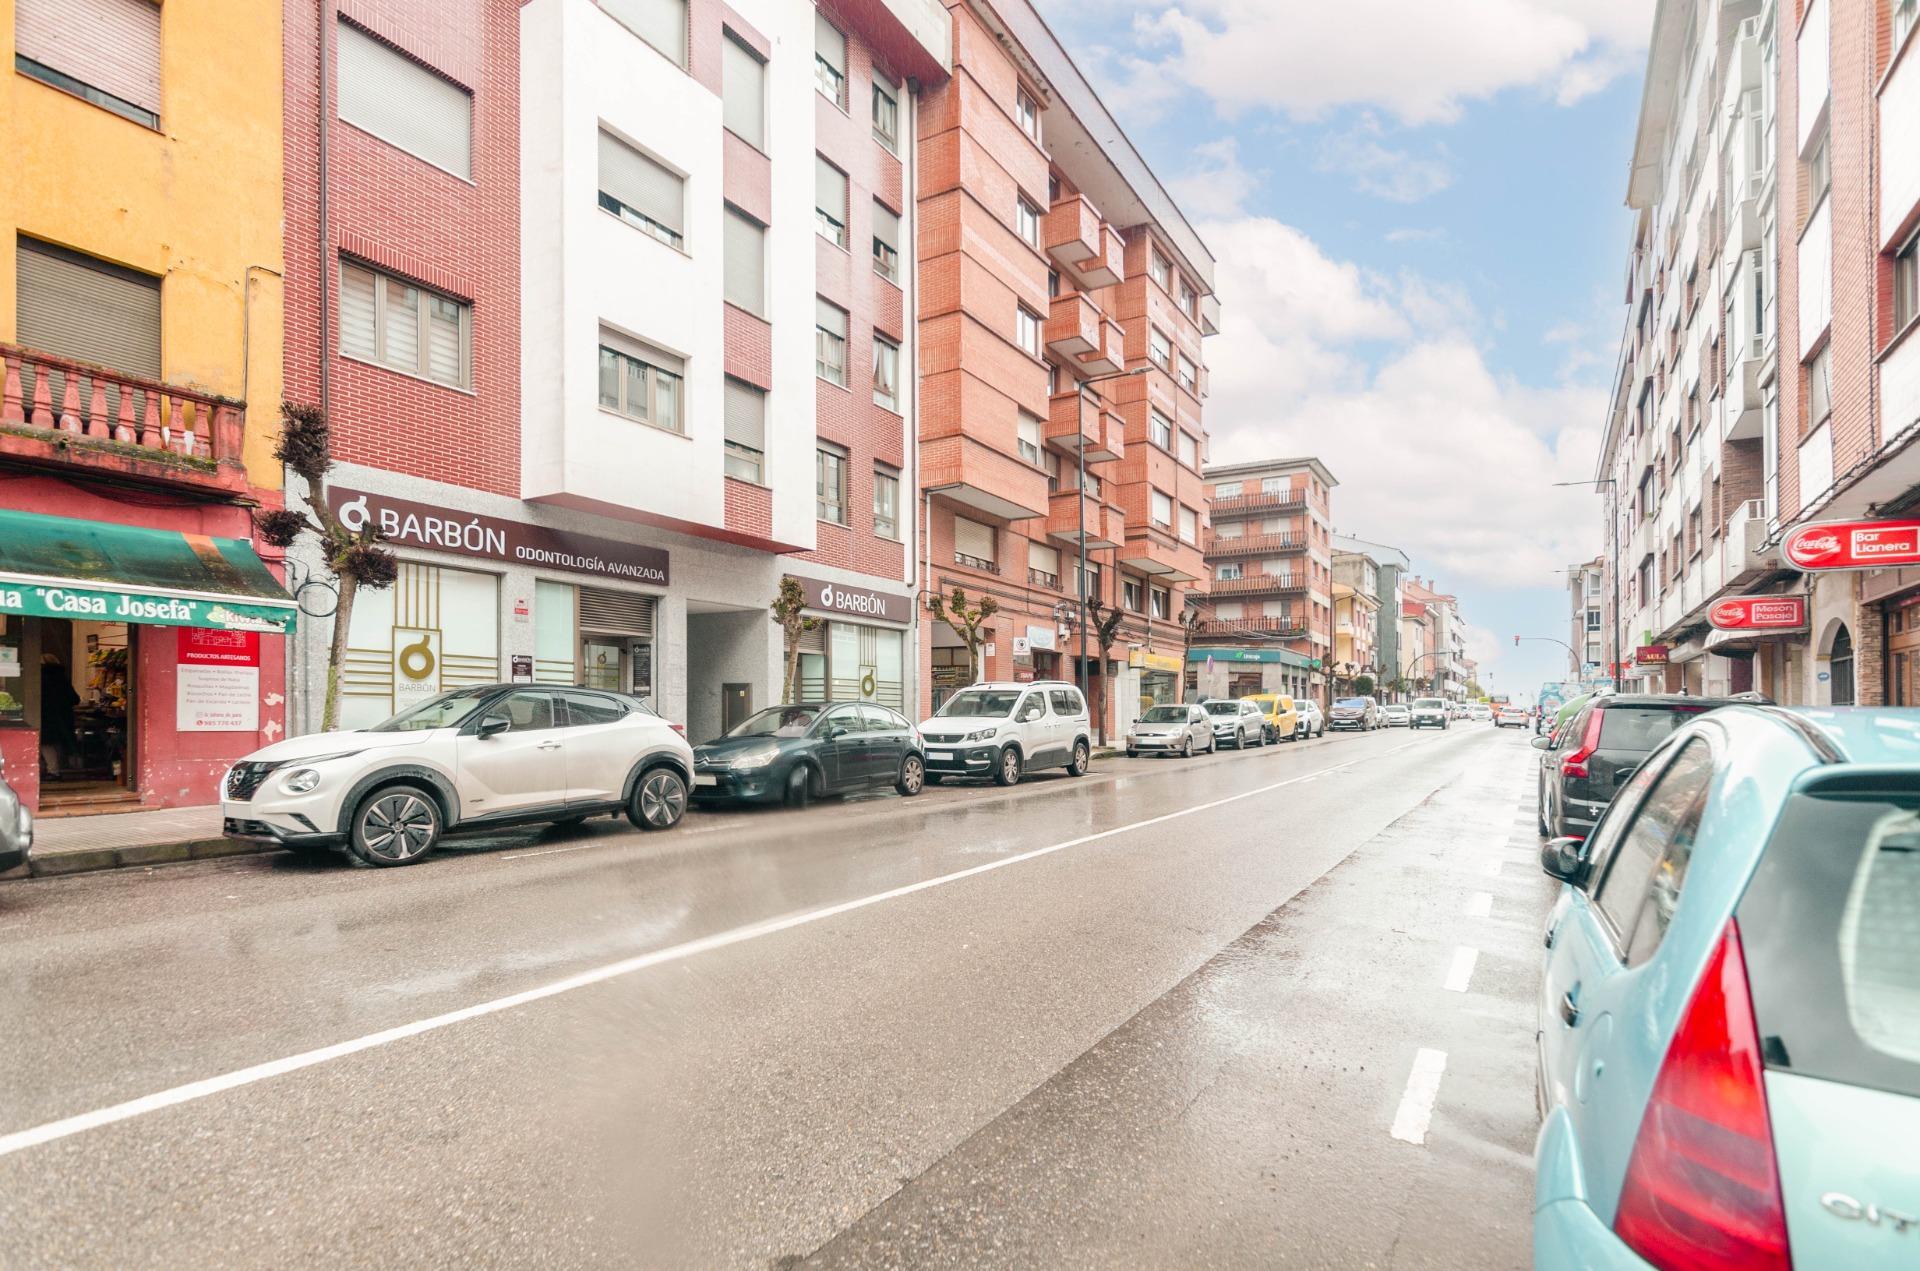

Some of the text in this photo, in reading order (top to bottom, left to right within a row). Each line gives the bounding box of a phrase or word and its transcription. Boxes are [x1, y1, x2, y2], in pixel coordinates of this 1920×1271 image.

[380, 508, 506, 556] BARBÓN
[1856, 533, 1879, 542] Bar
[1856, 542, 1910, 552] Llanera
[515, 546, 665, 581] ODONTOLOGÍA AVANZADA
[36, 588, 107, 614] "Casa
[116, 595, 196, 620] Josefa"
[836, 591, 886, 615] BARBÓN
